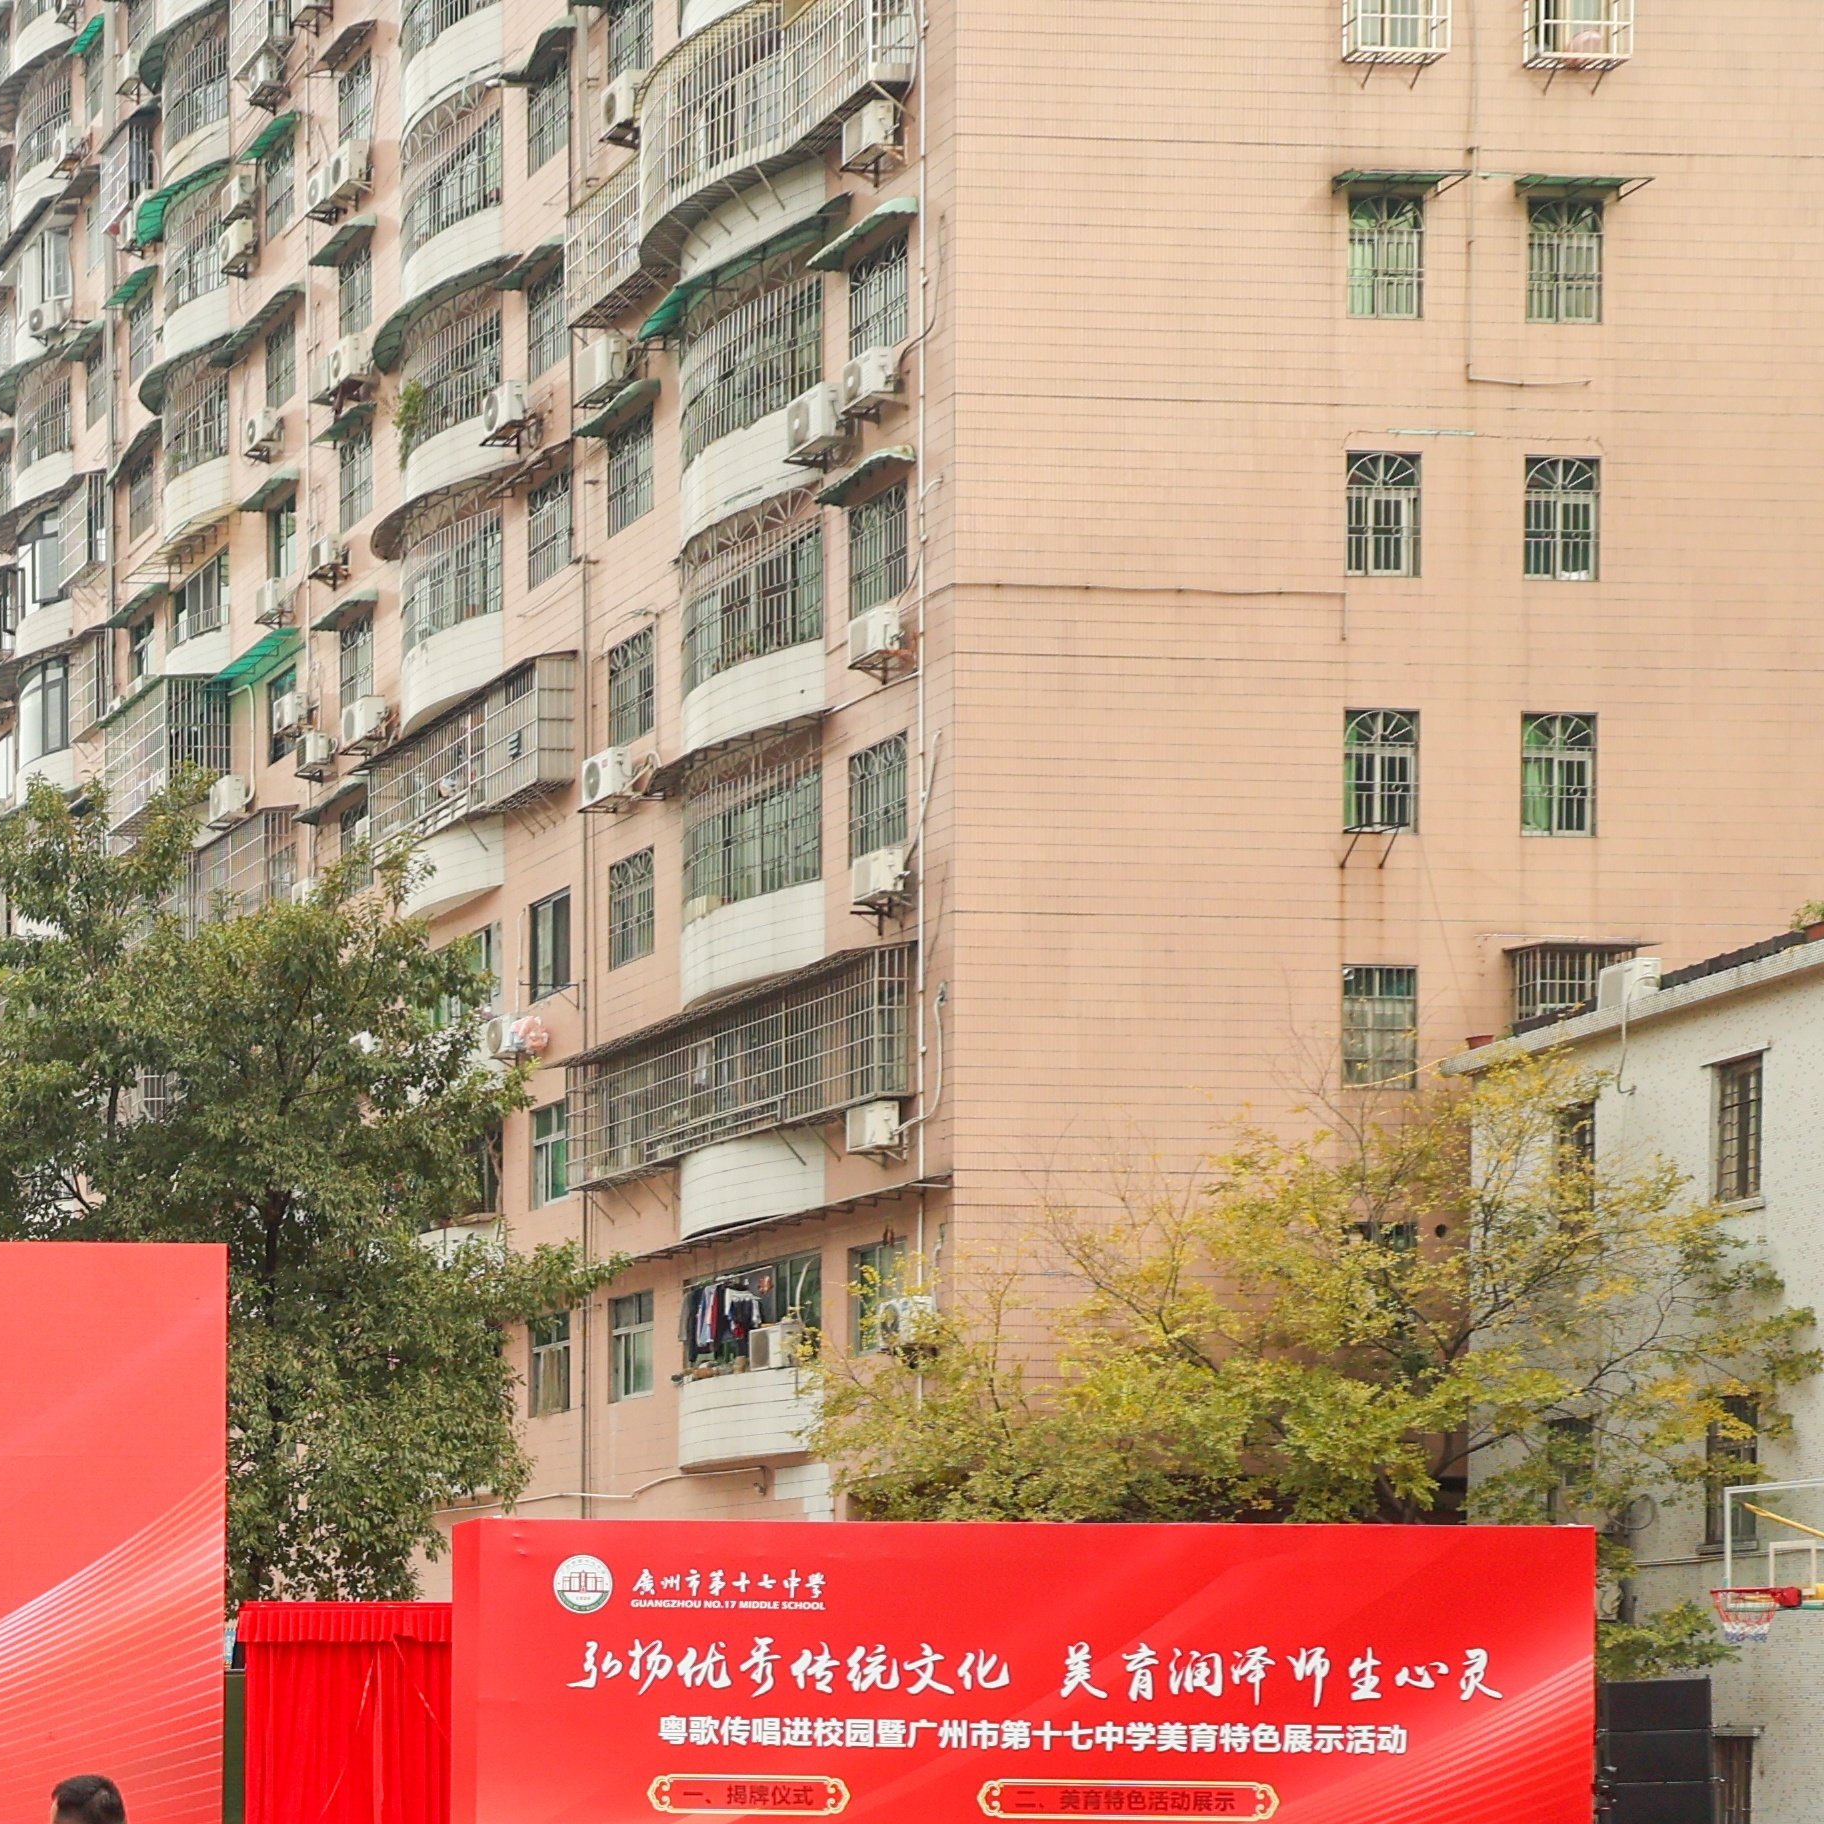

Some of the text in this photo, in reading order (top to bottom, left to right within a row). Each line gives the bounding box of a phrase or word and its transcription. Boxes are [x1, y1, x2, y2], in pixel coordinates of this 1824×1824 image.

[630, 1599, 826, 1611] GUANGZHOU NO.17 MIDDLE SCHOOL
[566, 1636, 1504, 1708] 弘扬优秀传统文化 美育润泽师生心灵
[657, 1714, 1408, 1755] 粤歌传唱进校园暨广州市第十七中学美育特色展示活动
[683, 1784, 814, 1806] 一、揭牌仪式
[1015, 1789, 1236, 1812] 二、美育特色活动展示
